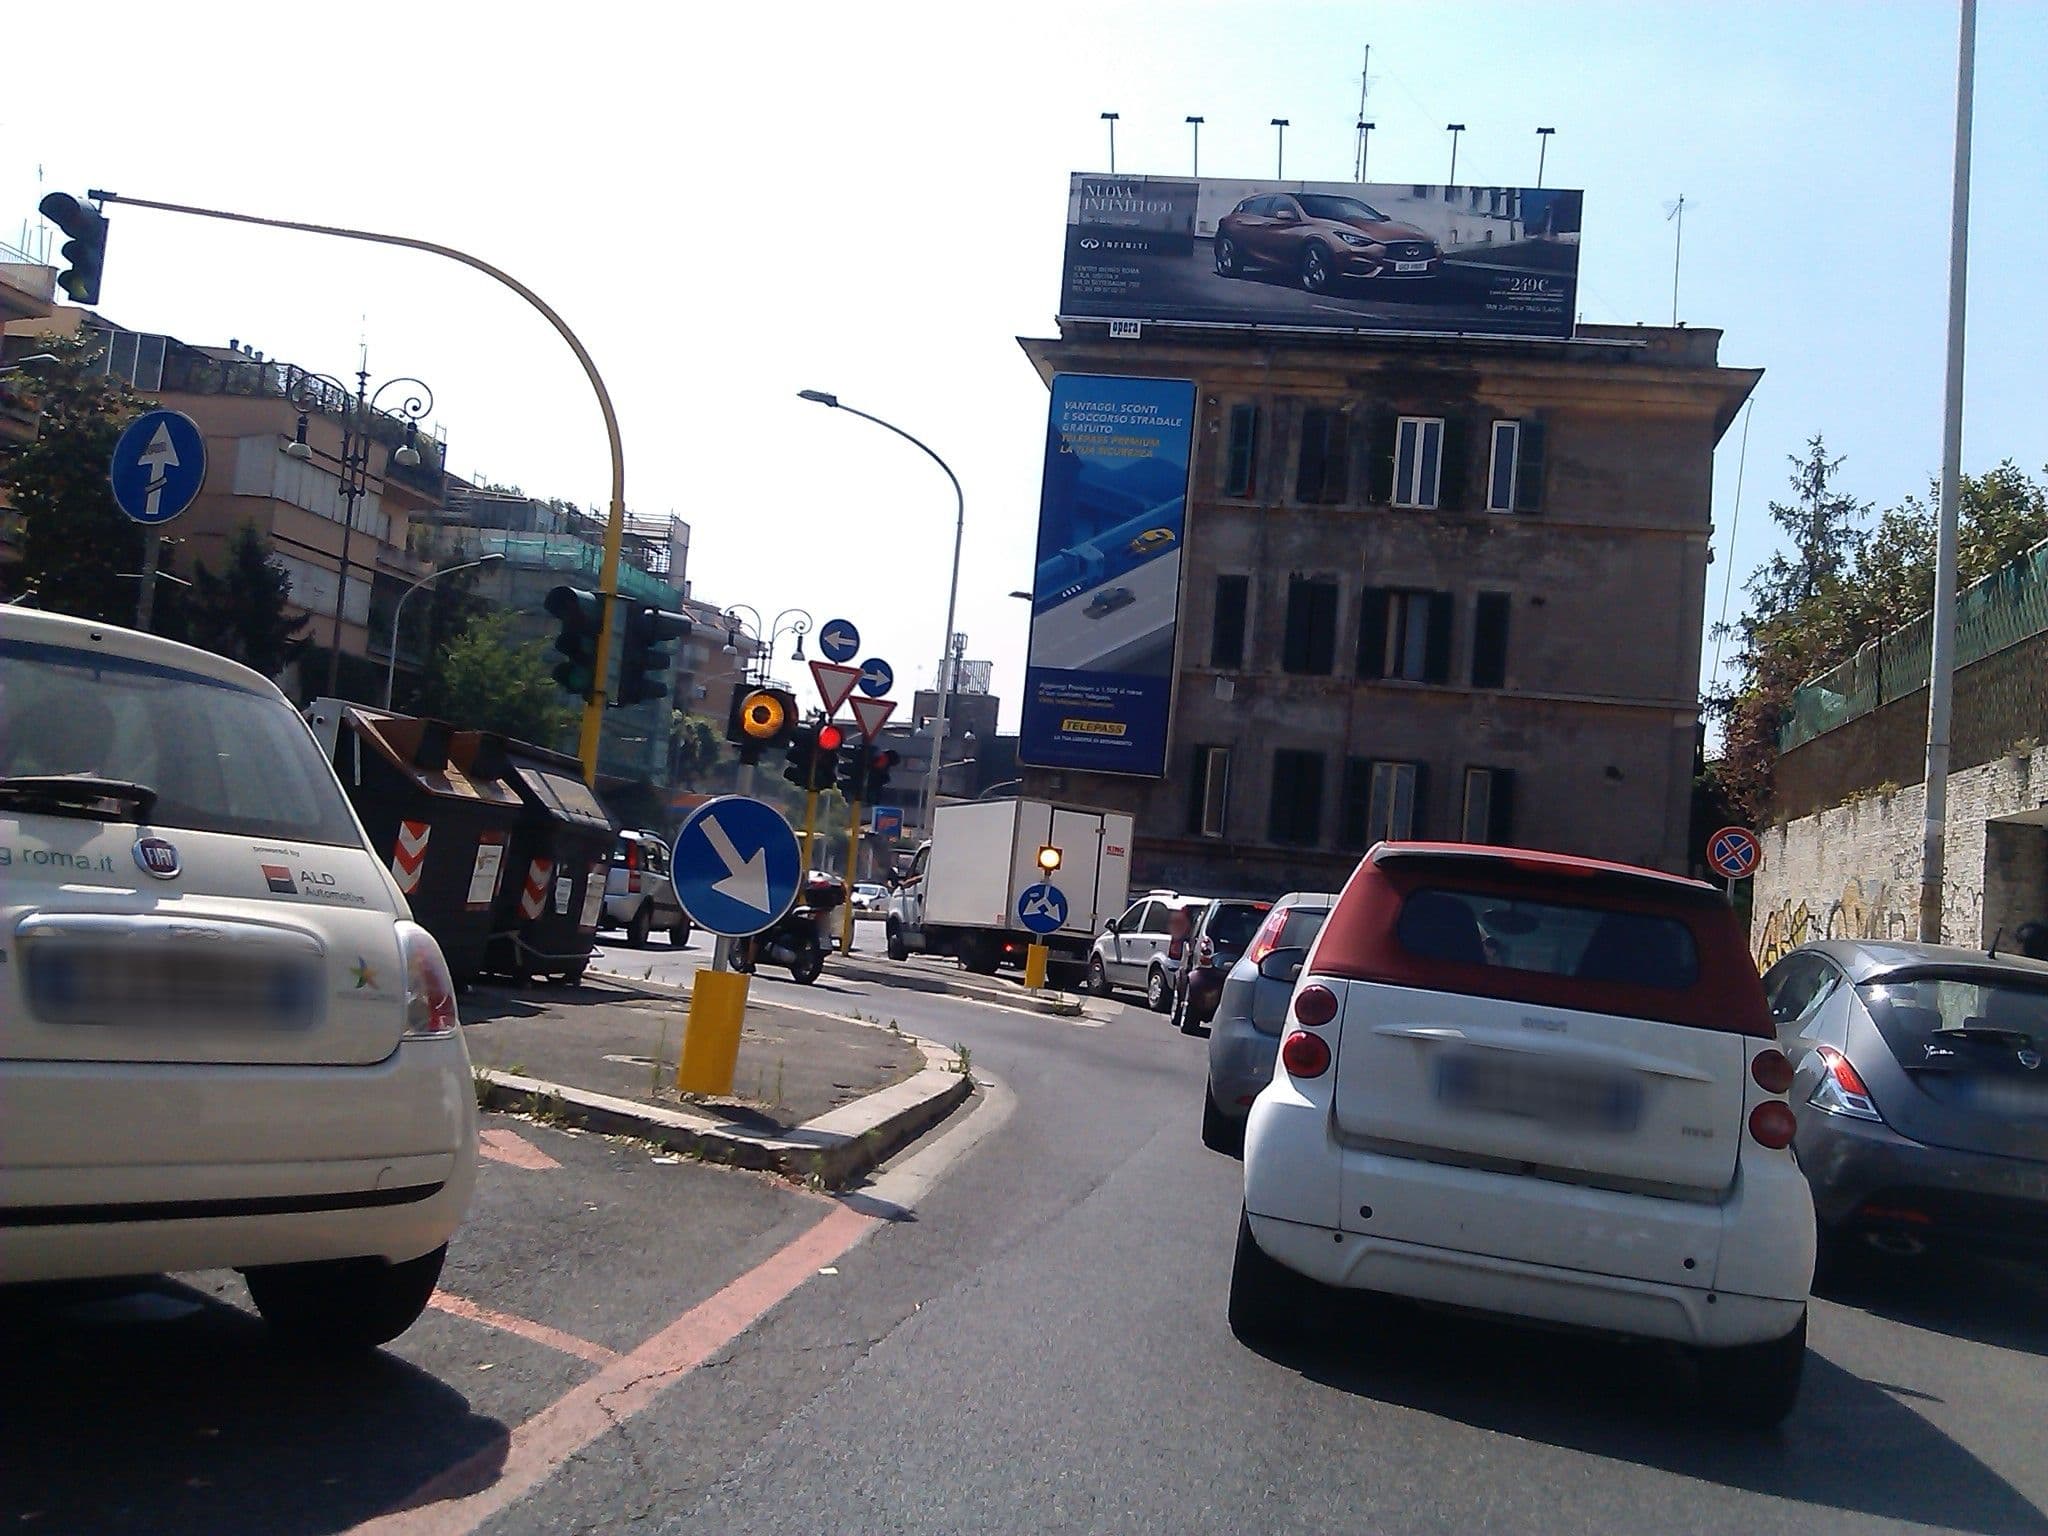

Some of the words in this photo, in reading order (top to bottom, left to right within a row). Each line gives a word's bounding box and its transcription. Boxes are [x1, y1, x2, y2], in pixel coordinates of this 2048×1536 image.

[1087, 184, 1133, 198] NUOVA
[1084, 198, 1144, 213] INFINITI
[1102, 241, 1148, 250] INFINITI
[1112, 321, 1138, 336] opera
[1120, 403, 1159, 414] SCONTI
[1063, 412, 1070, 420] E
[1071, 412, 1128, 424] SOCCORSO
[1130, 415, 1183, 427] STRADALE
[1062, 423, 1114, 434] GRATUITO
[1060, 444, 1073, 454] LA
[1065, 720, 1125, 734] TELEPASS
[145, 847, 176, 867] FIAT
[301, 870, 336, 886] ALD
[305, 886, 366, 904] Automotive
